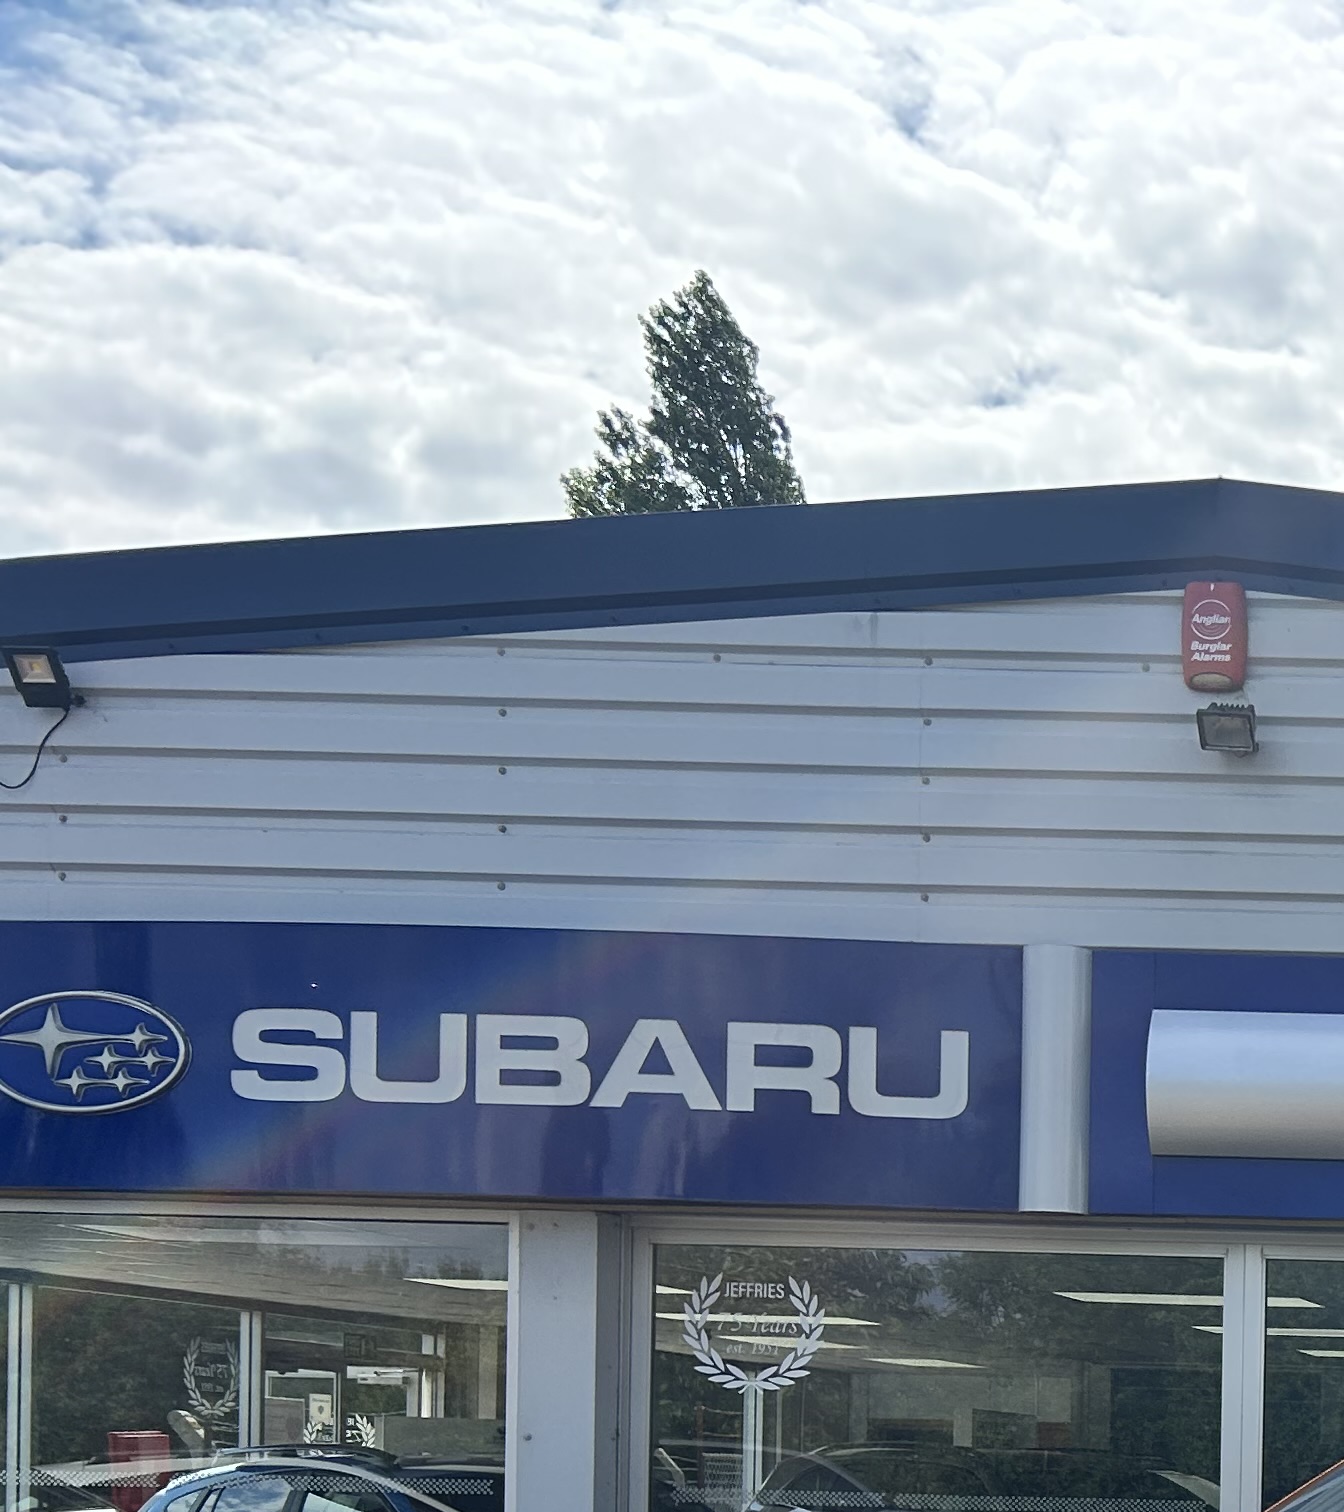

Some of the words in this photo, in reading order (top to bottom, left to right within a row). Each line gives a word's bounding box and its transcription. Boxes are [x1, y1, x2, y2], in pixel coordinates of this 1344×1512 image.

[1192, 614, 1231, 625] Anglian
[1191, 641, 1232, 652] Burglar
[1191, 652, 1231, 661] Alarms
[230, 1008, 969, 1119] SUBARU
[724, 1282, 785, 1299] JEFFRIES
[717, 1312, 743, 1331] 75
[748, 1312, 798, 1333] Years
